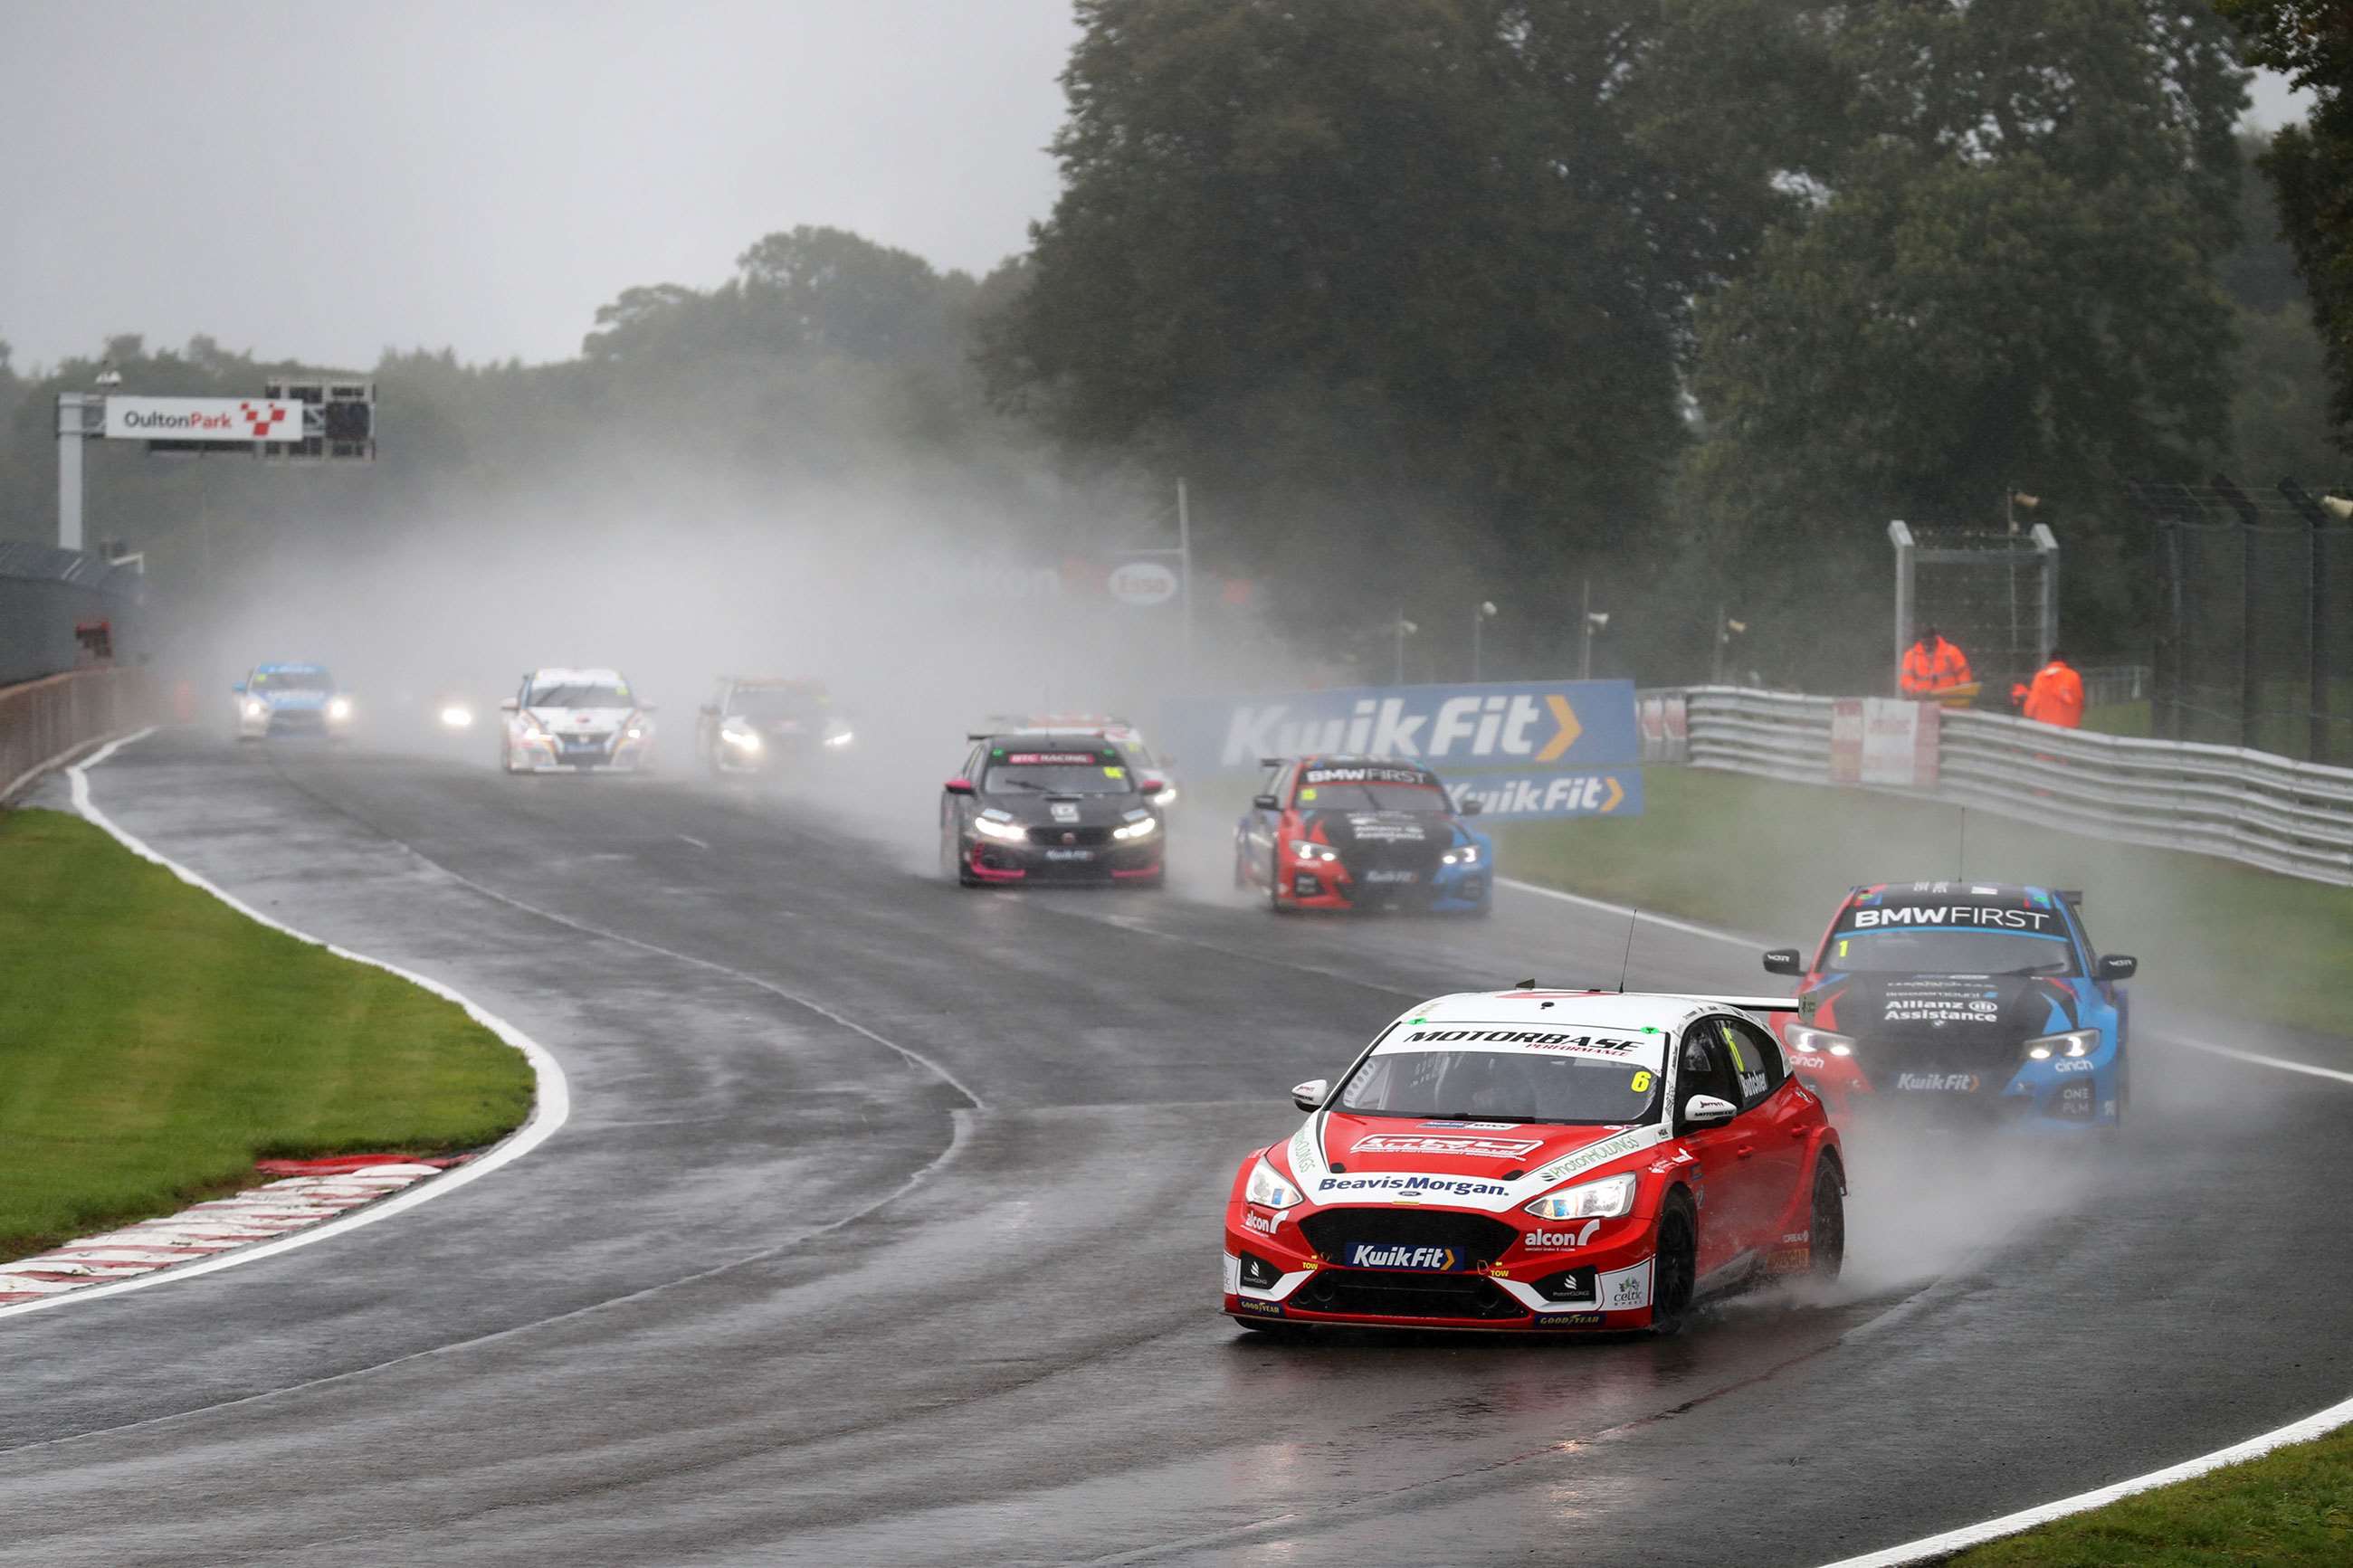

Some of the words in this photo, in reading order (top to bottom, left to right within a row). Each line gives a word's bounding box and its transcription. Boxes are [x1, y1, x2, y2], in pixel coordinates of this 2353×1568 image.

[124, 410, 232, 429] OultonPark
[1839, 941, 1849, 956] 1
[1885, 1000, 1964, 1010] Allianz
[1884, 1010, 1997, 1022] Assistance
[1404, 1031, 1645, 1052] MOTORBASE
[1525, 1043, 1630, 1057] PERFORMANCE
[1789, 1053, 1824, 1069] cinch
[2055, 1058, 2094, 1072] cinch
[1631, 1071, 1652, 1092] 6
[1245, 1210, 1270, 1232] alcon
[1525, 1229, 1576, 1246] alcon
[1303, 1262, 1319, 1270] TOW
[1540, 1314, 1599, 1325] GOODYEAR
